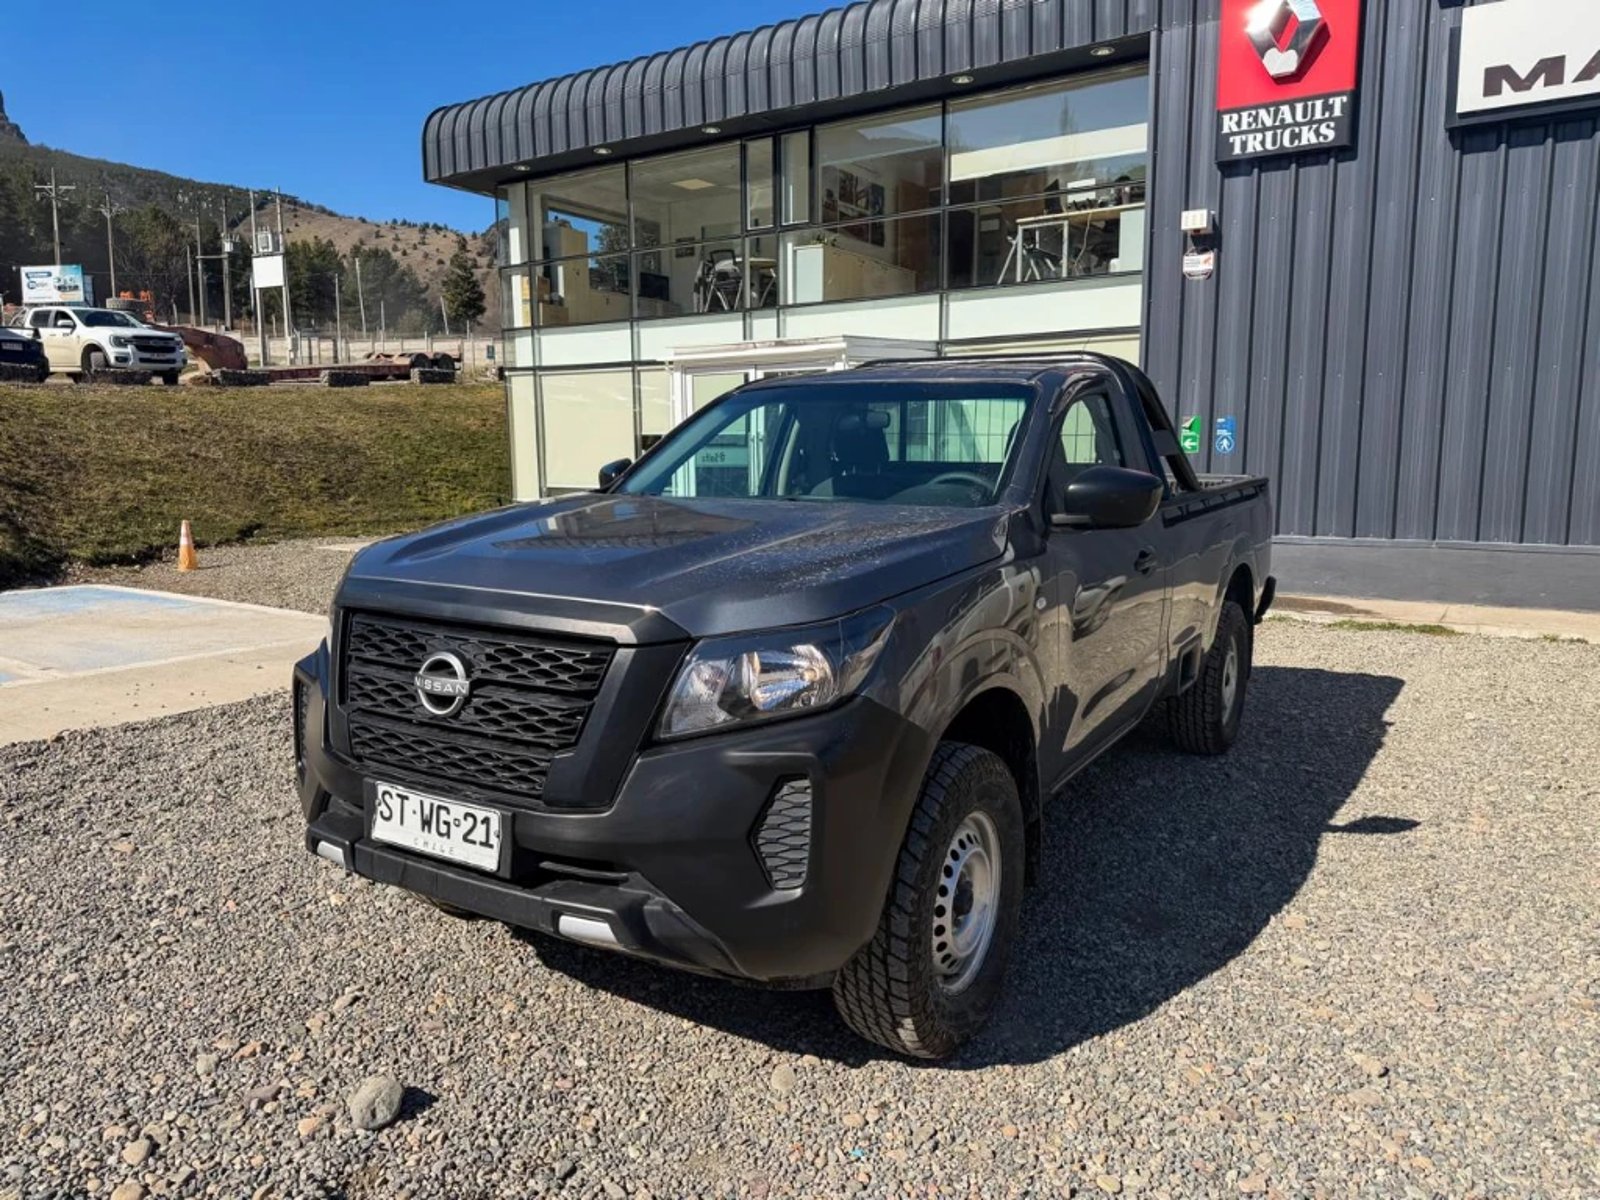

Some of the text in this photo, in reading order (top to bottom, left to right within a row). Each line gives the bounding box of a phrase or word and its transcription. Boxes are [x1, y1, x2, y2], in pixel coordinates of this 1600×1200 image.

[1221, 95, 1348, 134] RENAULT
[1229, 121, 1336, 156] TRUCKS
[414, 675, 467, 694] NISSAN
